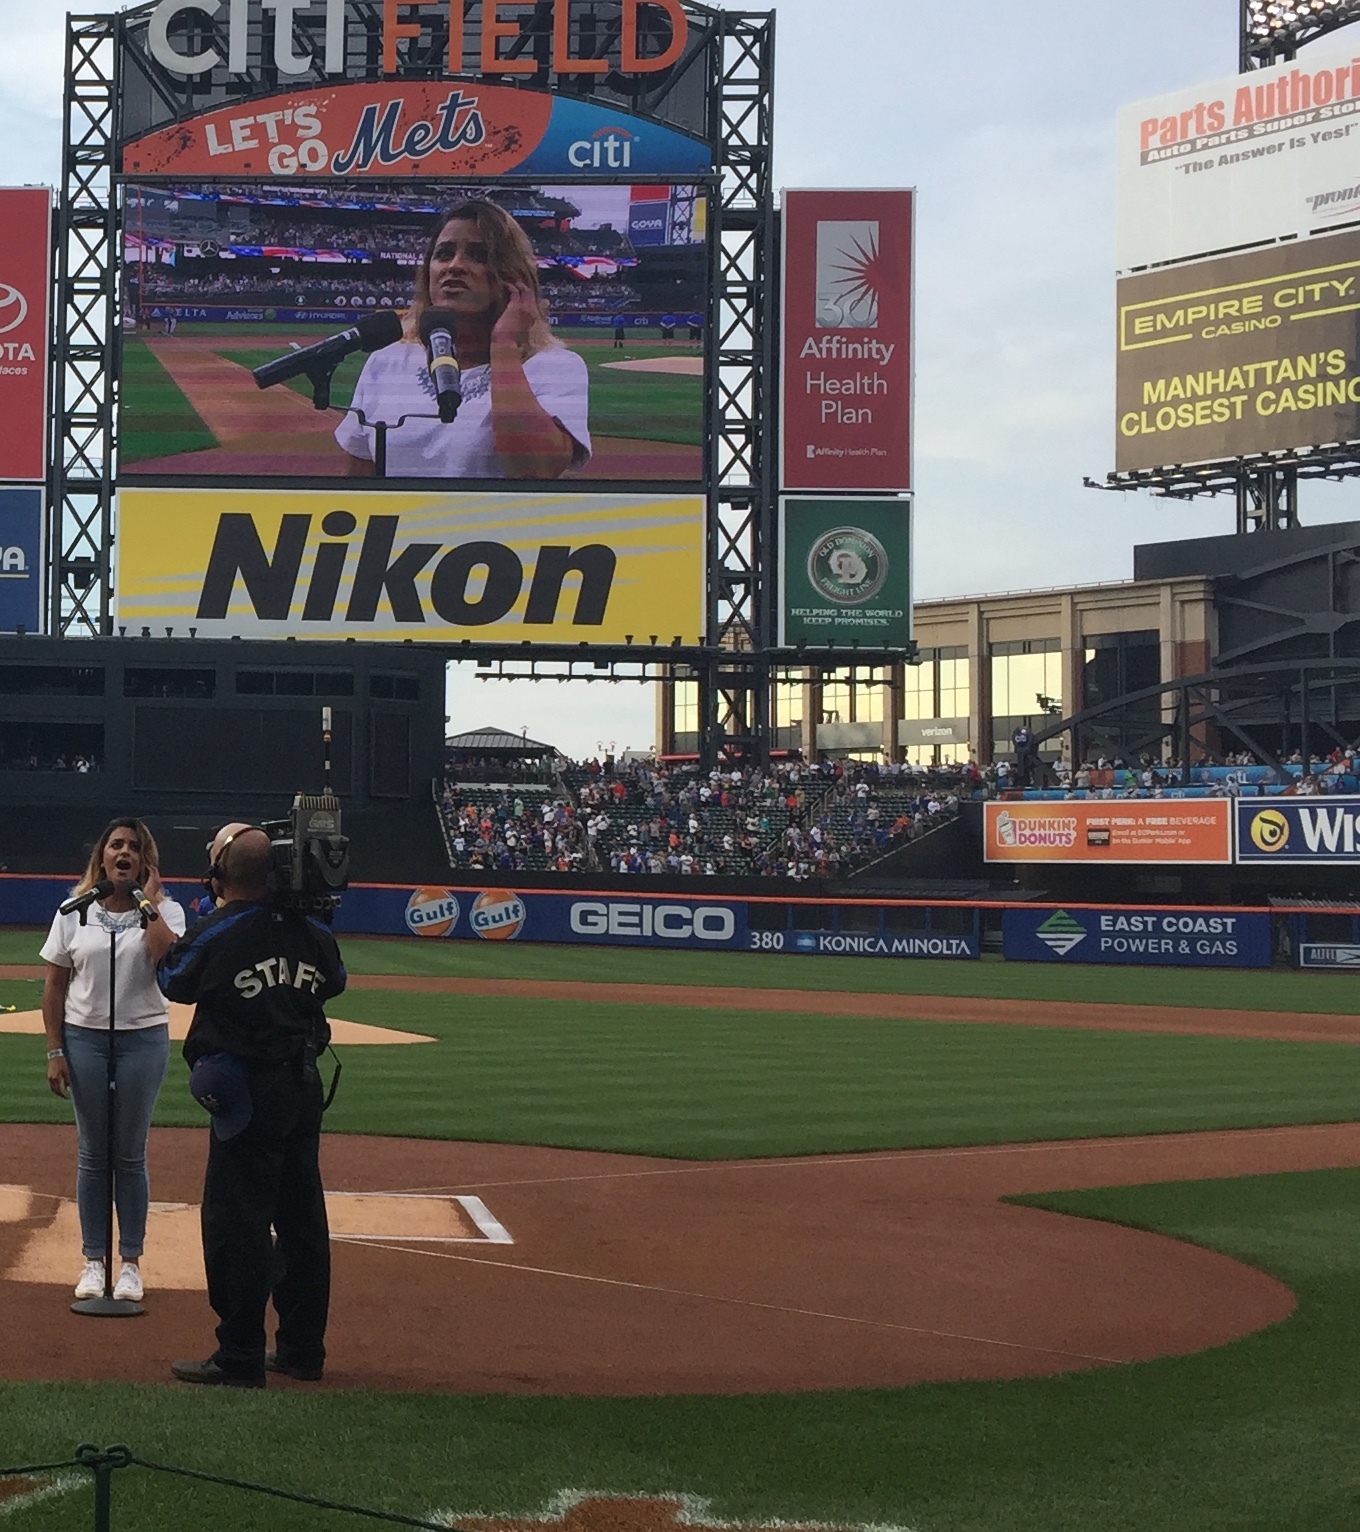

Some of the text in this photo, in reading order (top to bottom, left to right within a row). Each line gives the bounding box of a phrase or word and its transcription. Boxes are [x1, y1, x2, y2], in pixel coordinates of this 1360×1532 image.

[383, 0, 689, 73] FIELD
[1141, 57, 1360, 150] Parts Authori
[205, 103, 322, 157] LET'S
[267, 90, 485, 176] GO Mets
[1146, 143, 1191, 162] Auto
[1196, 127, 1249, 150] Parts
[1253, 112, 1315, 135] Super
[568, 133, 632, 168] citi
[1218, 140, 1285, 167] Answer
[1289, 136, 1306, 150] Is
[1134, 277, 1354, 335] EMPIRE CITY
[1201, 315, 1281, 339] CASINO
[800, 335, 895, 366] Affinity
[806, 371, 888, 395] Health
[1143, 349, 1346, 405] MANHATTAN'S
[821, 400, 872, 424] Plan
[1120, 395, 1248, 437] CLOSEST
[819, 541, 835, 557] OLD
[196, 510, 618, 627] Nikon
[791, 608, 904, 618] HELPING THE WORLD
[803, 617, 832, 625] KEEP
[920, 725, 952, 738] verizon
[1018, 817, 1077, 834] DUNKIN'
[1169, 817, 1217, 826] BEVERAGE
[1018, 831, 1074, 848] DONUTS
[409, 901, 456, 926] Gulf
[474, 904, 521, 930] Gulf
[570, 901, 735, 940] GEICO
[1100, 915, 1236, 934] EAST COAST
[750, 931, 784, 950] 380
[819, 934, 971, 955] KONICA MINOLTA
[1101, 937, 1238, 956] POWER & GAS
[234, 956, 326, 999] STAFF
